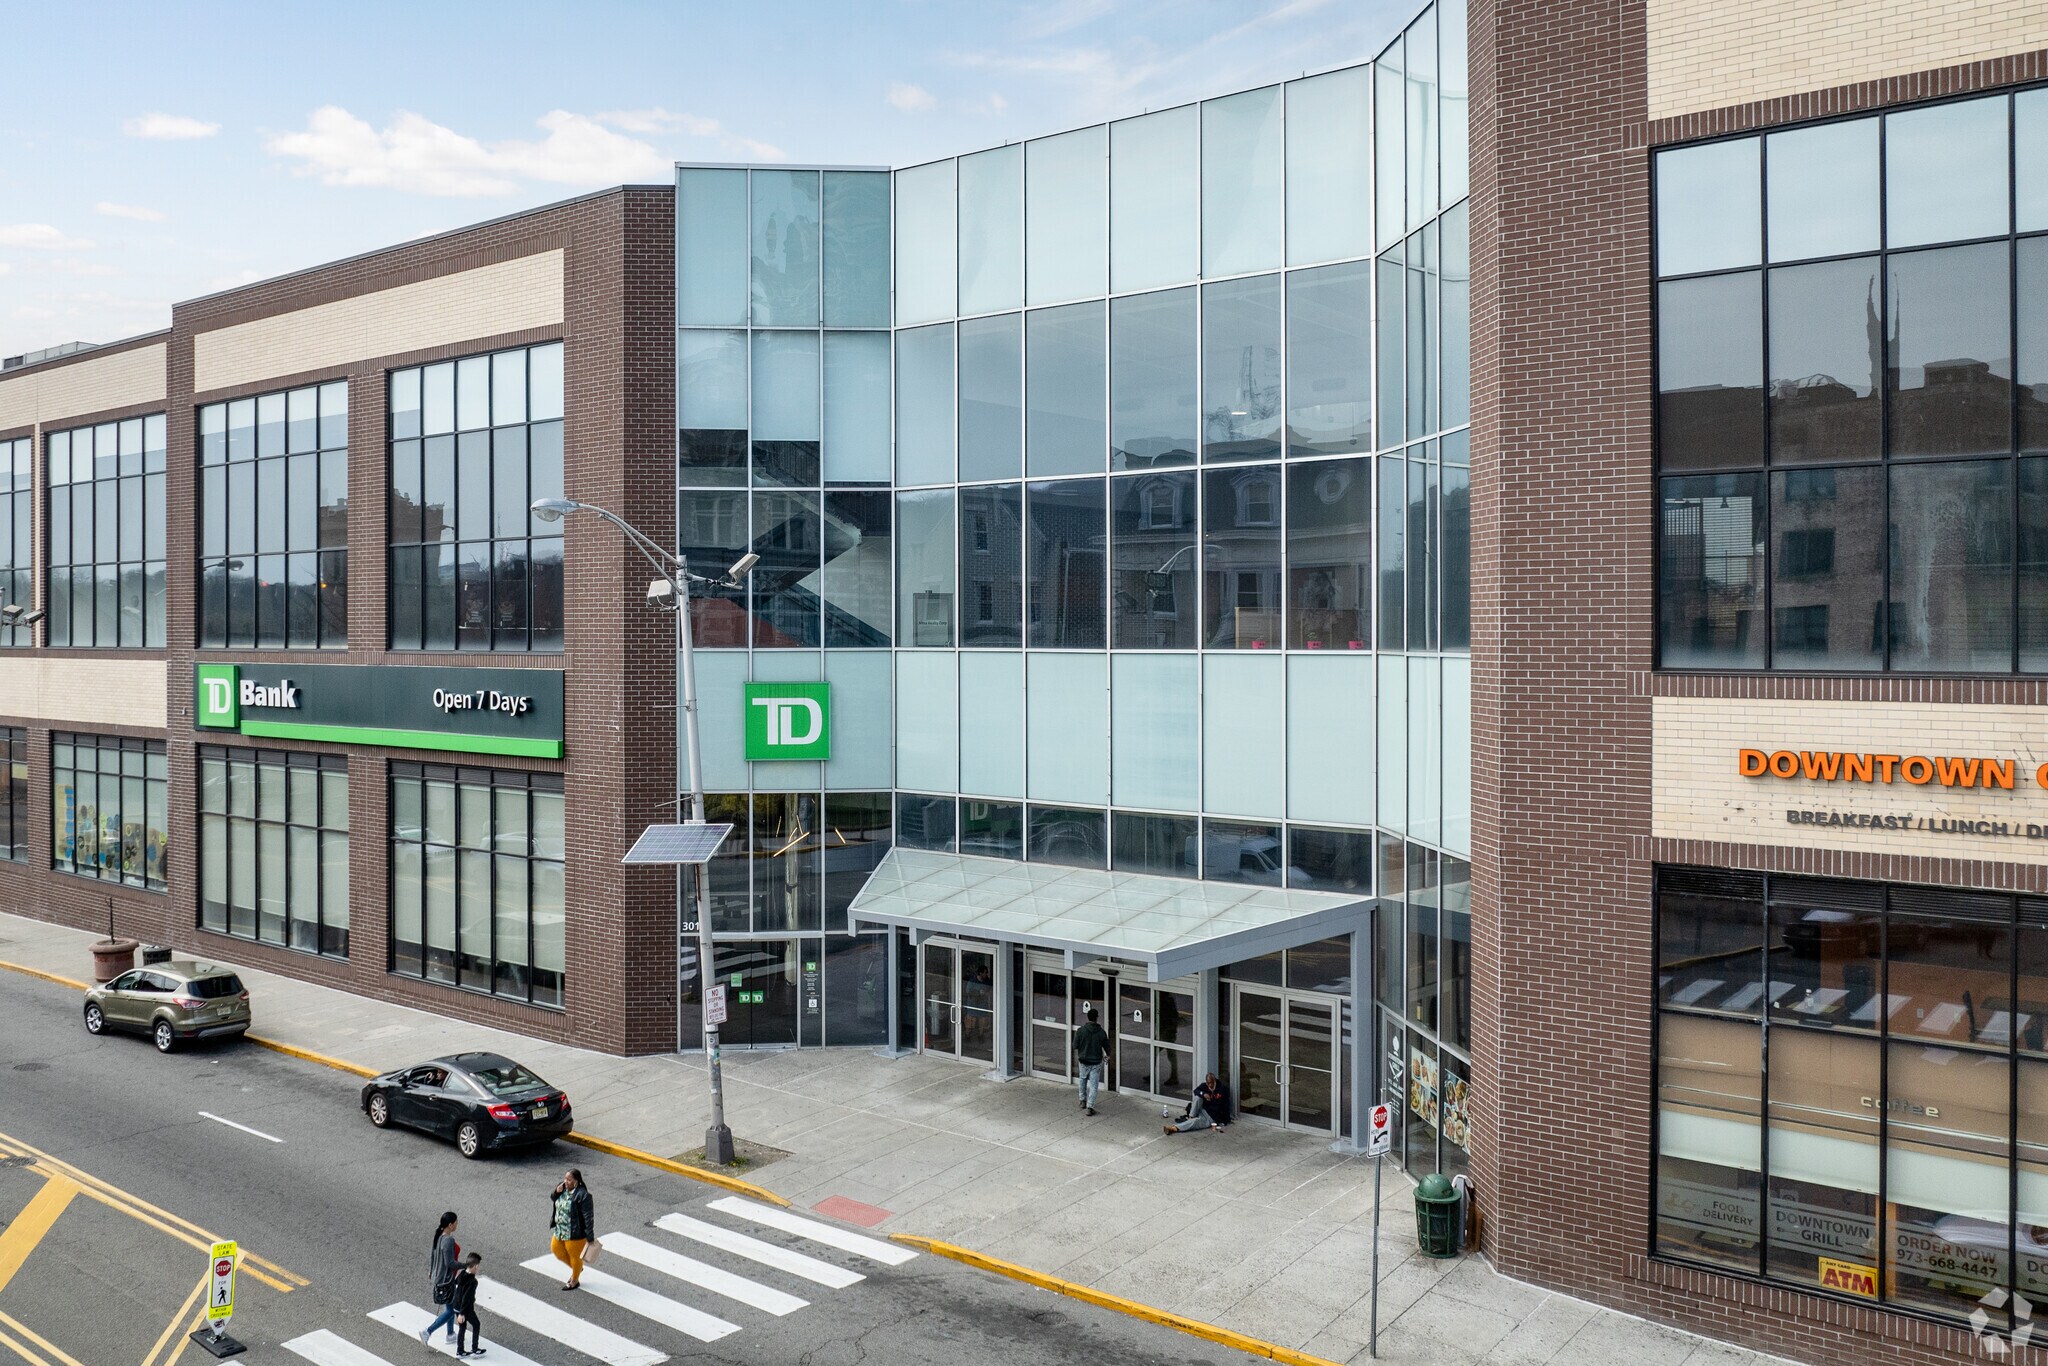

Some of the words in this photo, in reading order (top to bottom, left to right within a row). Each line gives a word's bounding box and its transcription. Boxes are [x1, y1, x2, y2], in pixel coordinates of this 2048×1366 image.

[203, 678, 231, 714] TD
[240, 679, 297, 708] Bank
[432, 688, 472, 714] Open
[476, 690, 485, 710] 7
[489, 690, 528, 717] Days
[752, 697, 823, 745] TD
[1738, 748, 2015, 790] DOWNTOWN
[1787, 809, 1912, 831] BREAKFAST
[1928, 817, 2008, 838] LUNCH
[711, 989, 719, 997] NO
[741, 994, 750, 1002] TD
[753, 994, 763, 1002] TD
[1374, 1112, 1387, 1124] STOP
[1702, 1208, 1753, 1226] DELIVERY
[1776, 1210, 1870, 1239] DOWNTOWN
[1801, 1229, 1844, 1248] GRILL
[1897, 1234, 1952, 1256] ORDER
[1955, 1246, 1997, 1265] NOW
[216, 1264, 231, 1273] STOP
[1897, 1248, 1998, 1279] 973-668-4447
[1822, 1267, 1875, 1296] ATM
